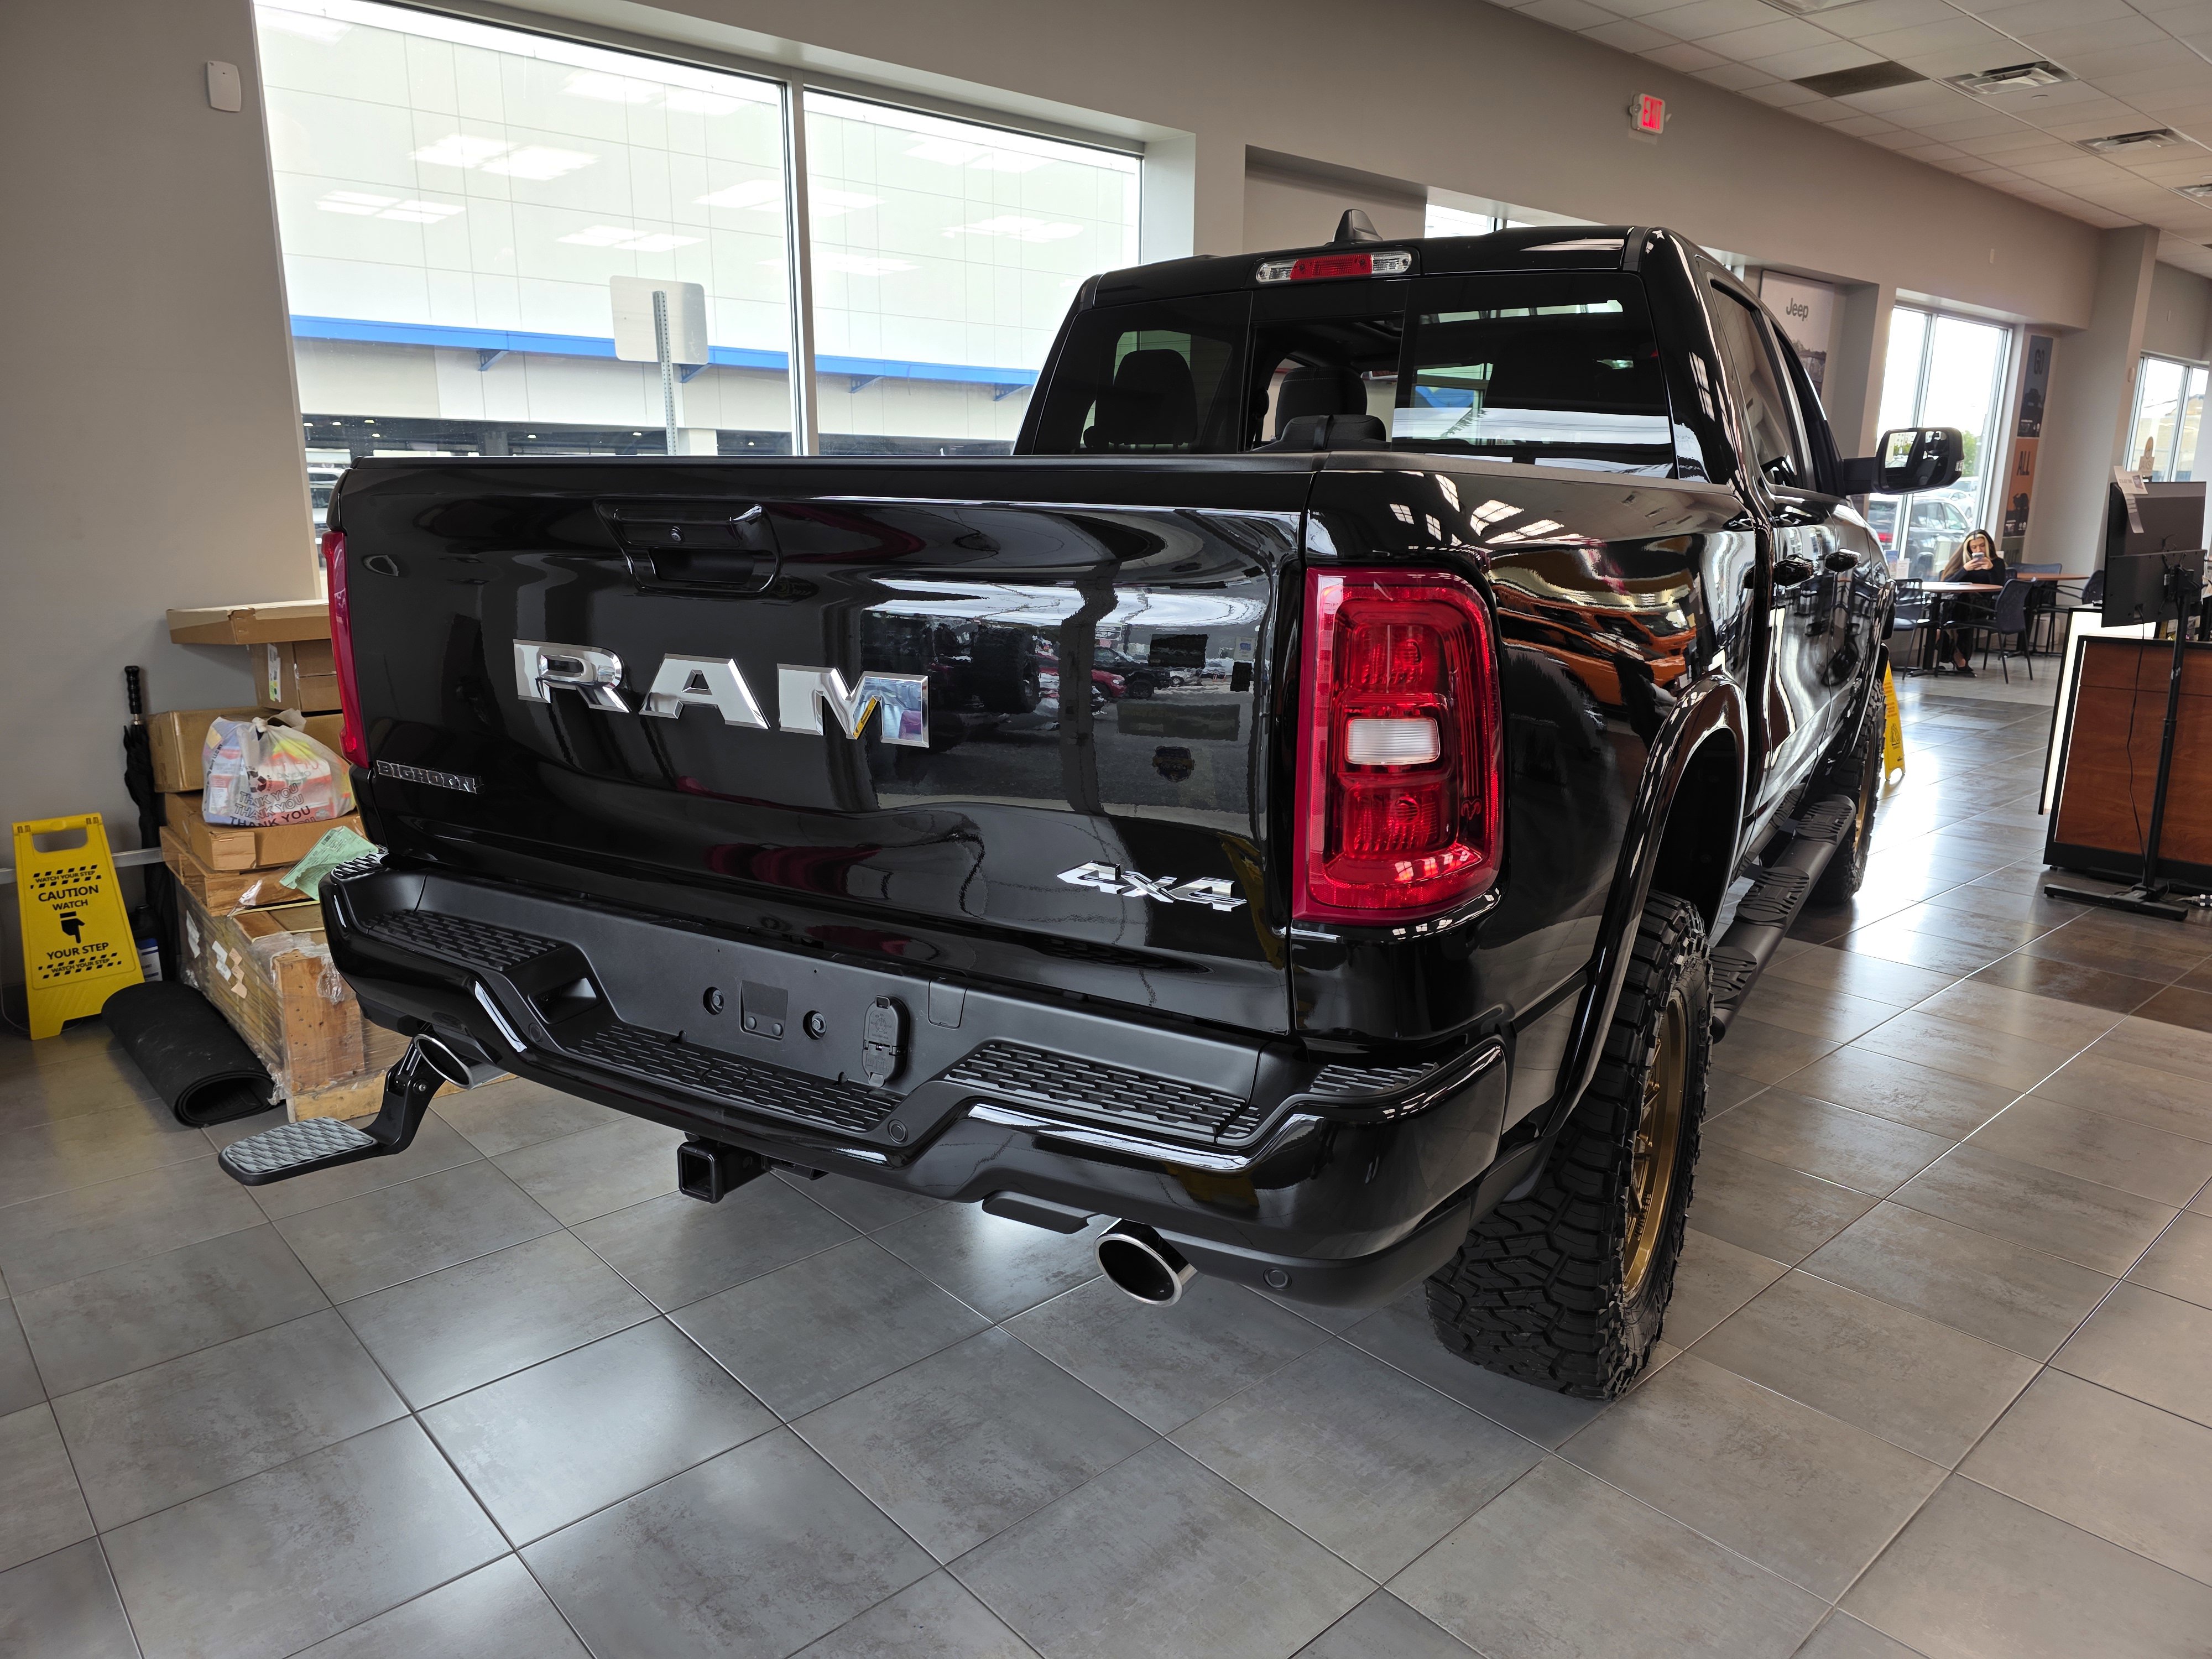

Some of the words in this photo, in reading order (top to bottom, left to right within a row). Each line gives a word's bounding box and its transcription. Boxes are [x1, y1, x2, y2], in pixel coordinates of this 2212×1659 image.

[1642, 96, 1663, 131] EXIT
[1786, 298, 1809, 321] Jeep
[2034, 349, 2045, 375] GO
[2016, 451, 2031, 476] ALL
[513, 639, 930, 748] RAM
[376, 760, 477, 795] BIGHORN
[234, 803, 275, 820] THANK
[274, 794, 304, 813] YOU
[239, 791, 272, 808] THNK
[270, 782, 299, 801] YOU
[281, 805, 311, 822] YOU
[38, 885, 99, 902] CAUTION
[53, 899, 88, 911] WATCH
[47, 947, 80, 960] YOUR
[82, 942, 109, 954] STEP
